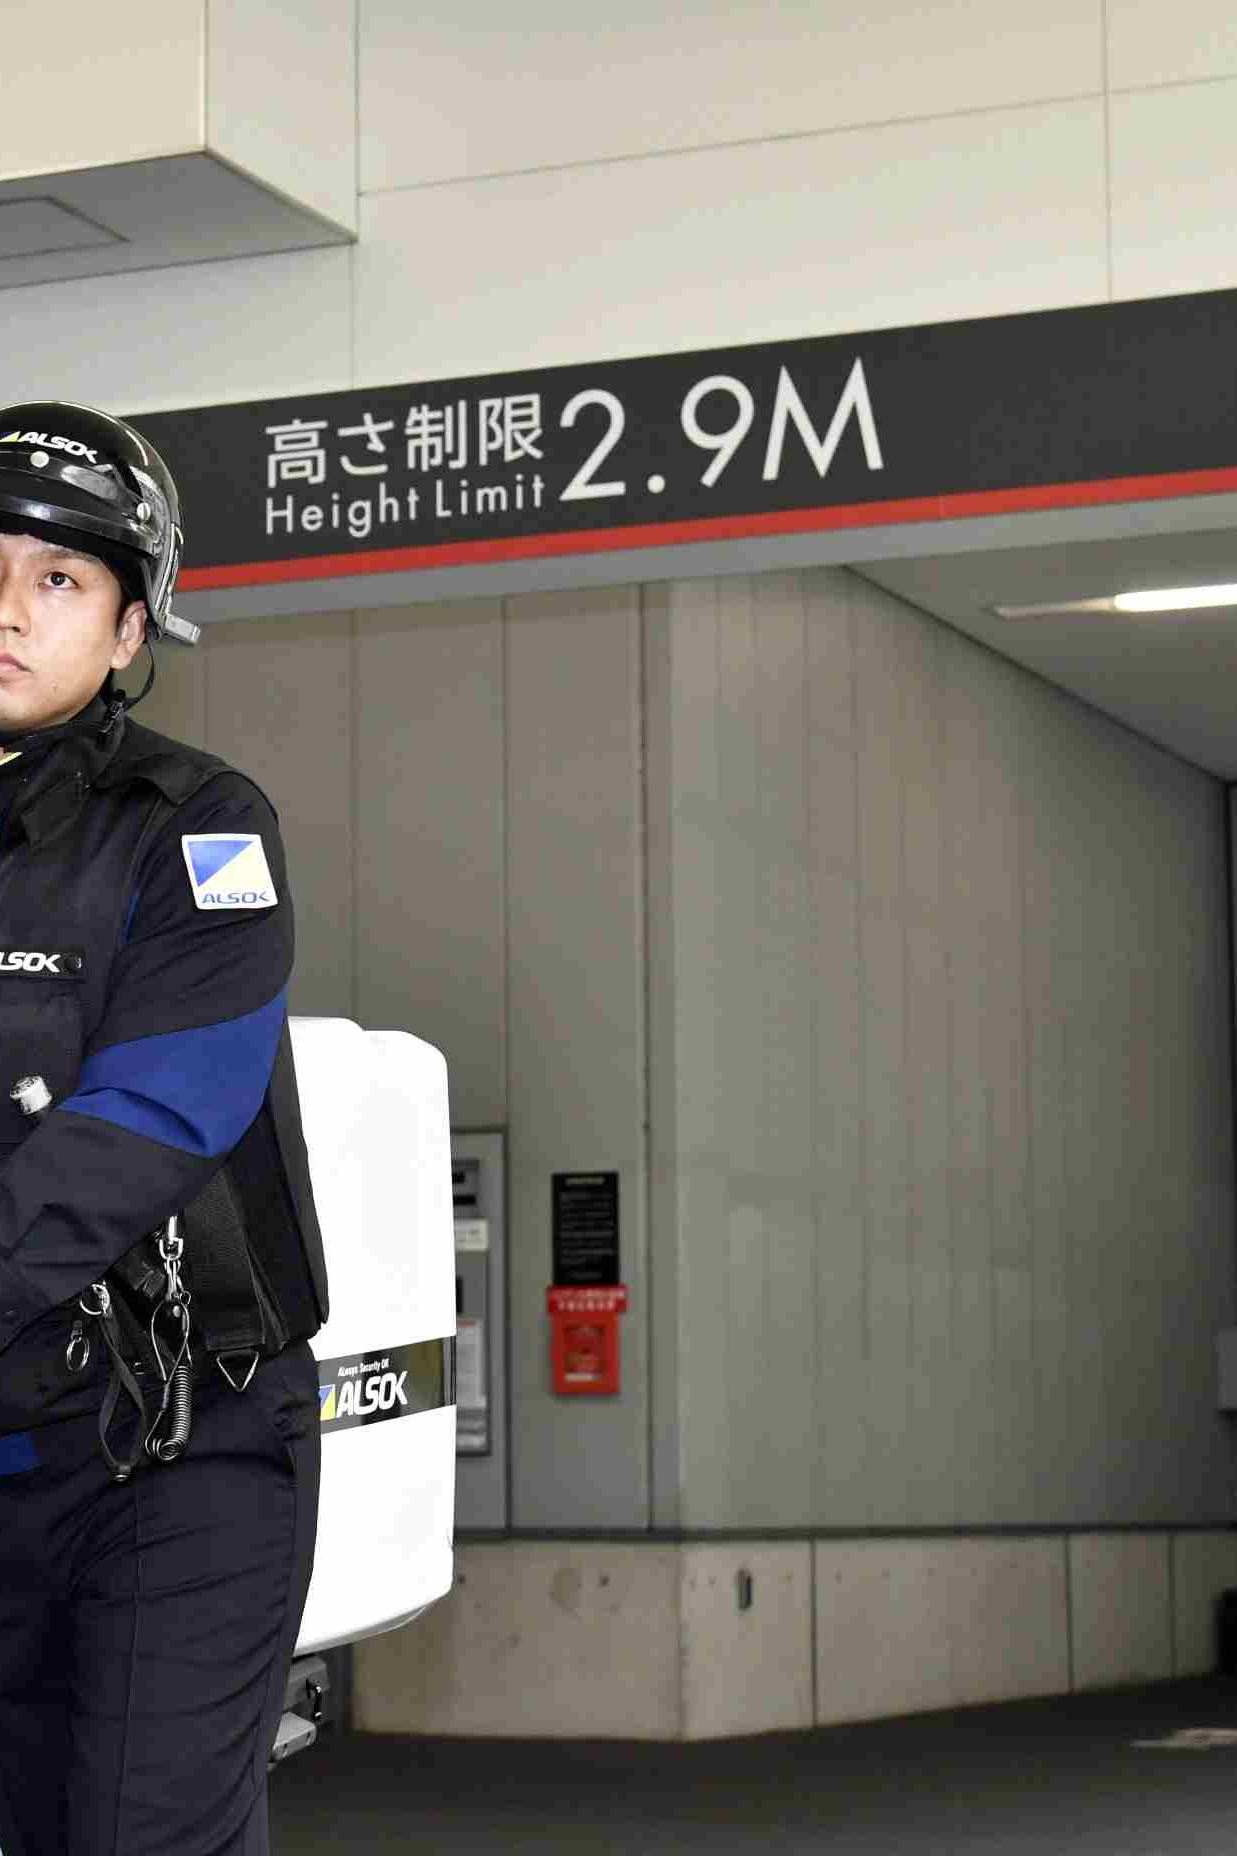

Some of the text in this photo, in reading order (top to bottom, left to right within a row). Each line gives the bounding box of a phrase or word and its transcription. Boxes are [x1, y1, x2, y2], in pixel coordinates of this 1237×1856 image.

[18, 431, 98, 464] ALSOK
[265, 356, 885, 501] 高さ制限 2.9M
[265, 473, 546, 539] Height Limit
[201, 890, 270, 905] ALSOK
[336, 1371, 409, 1418] ALSOK
